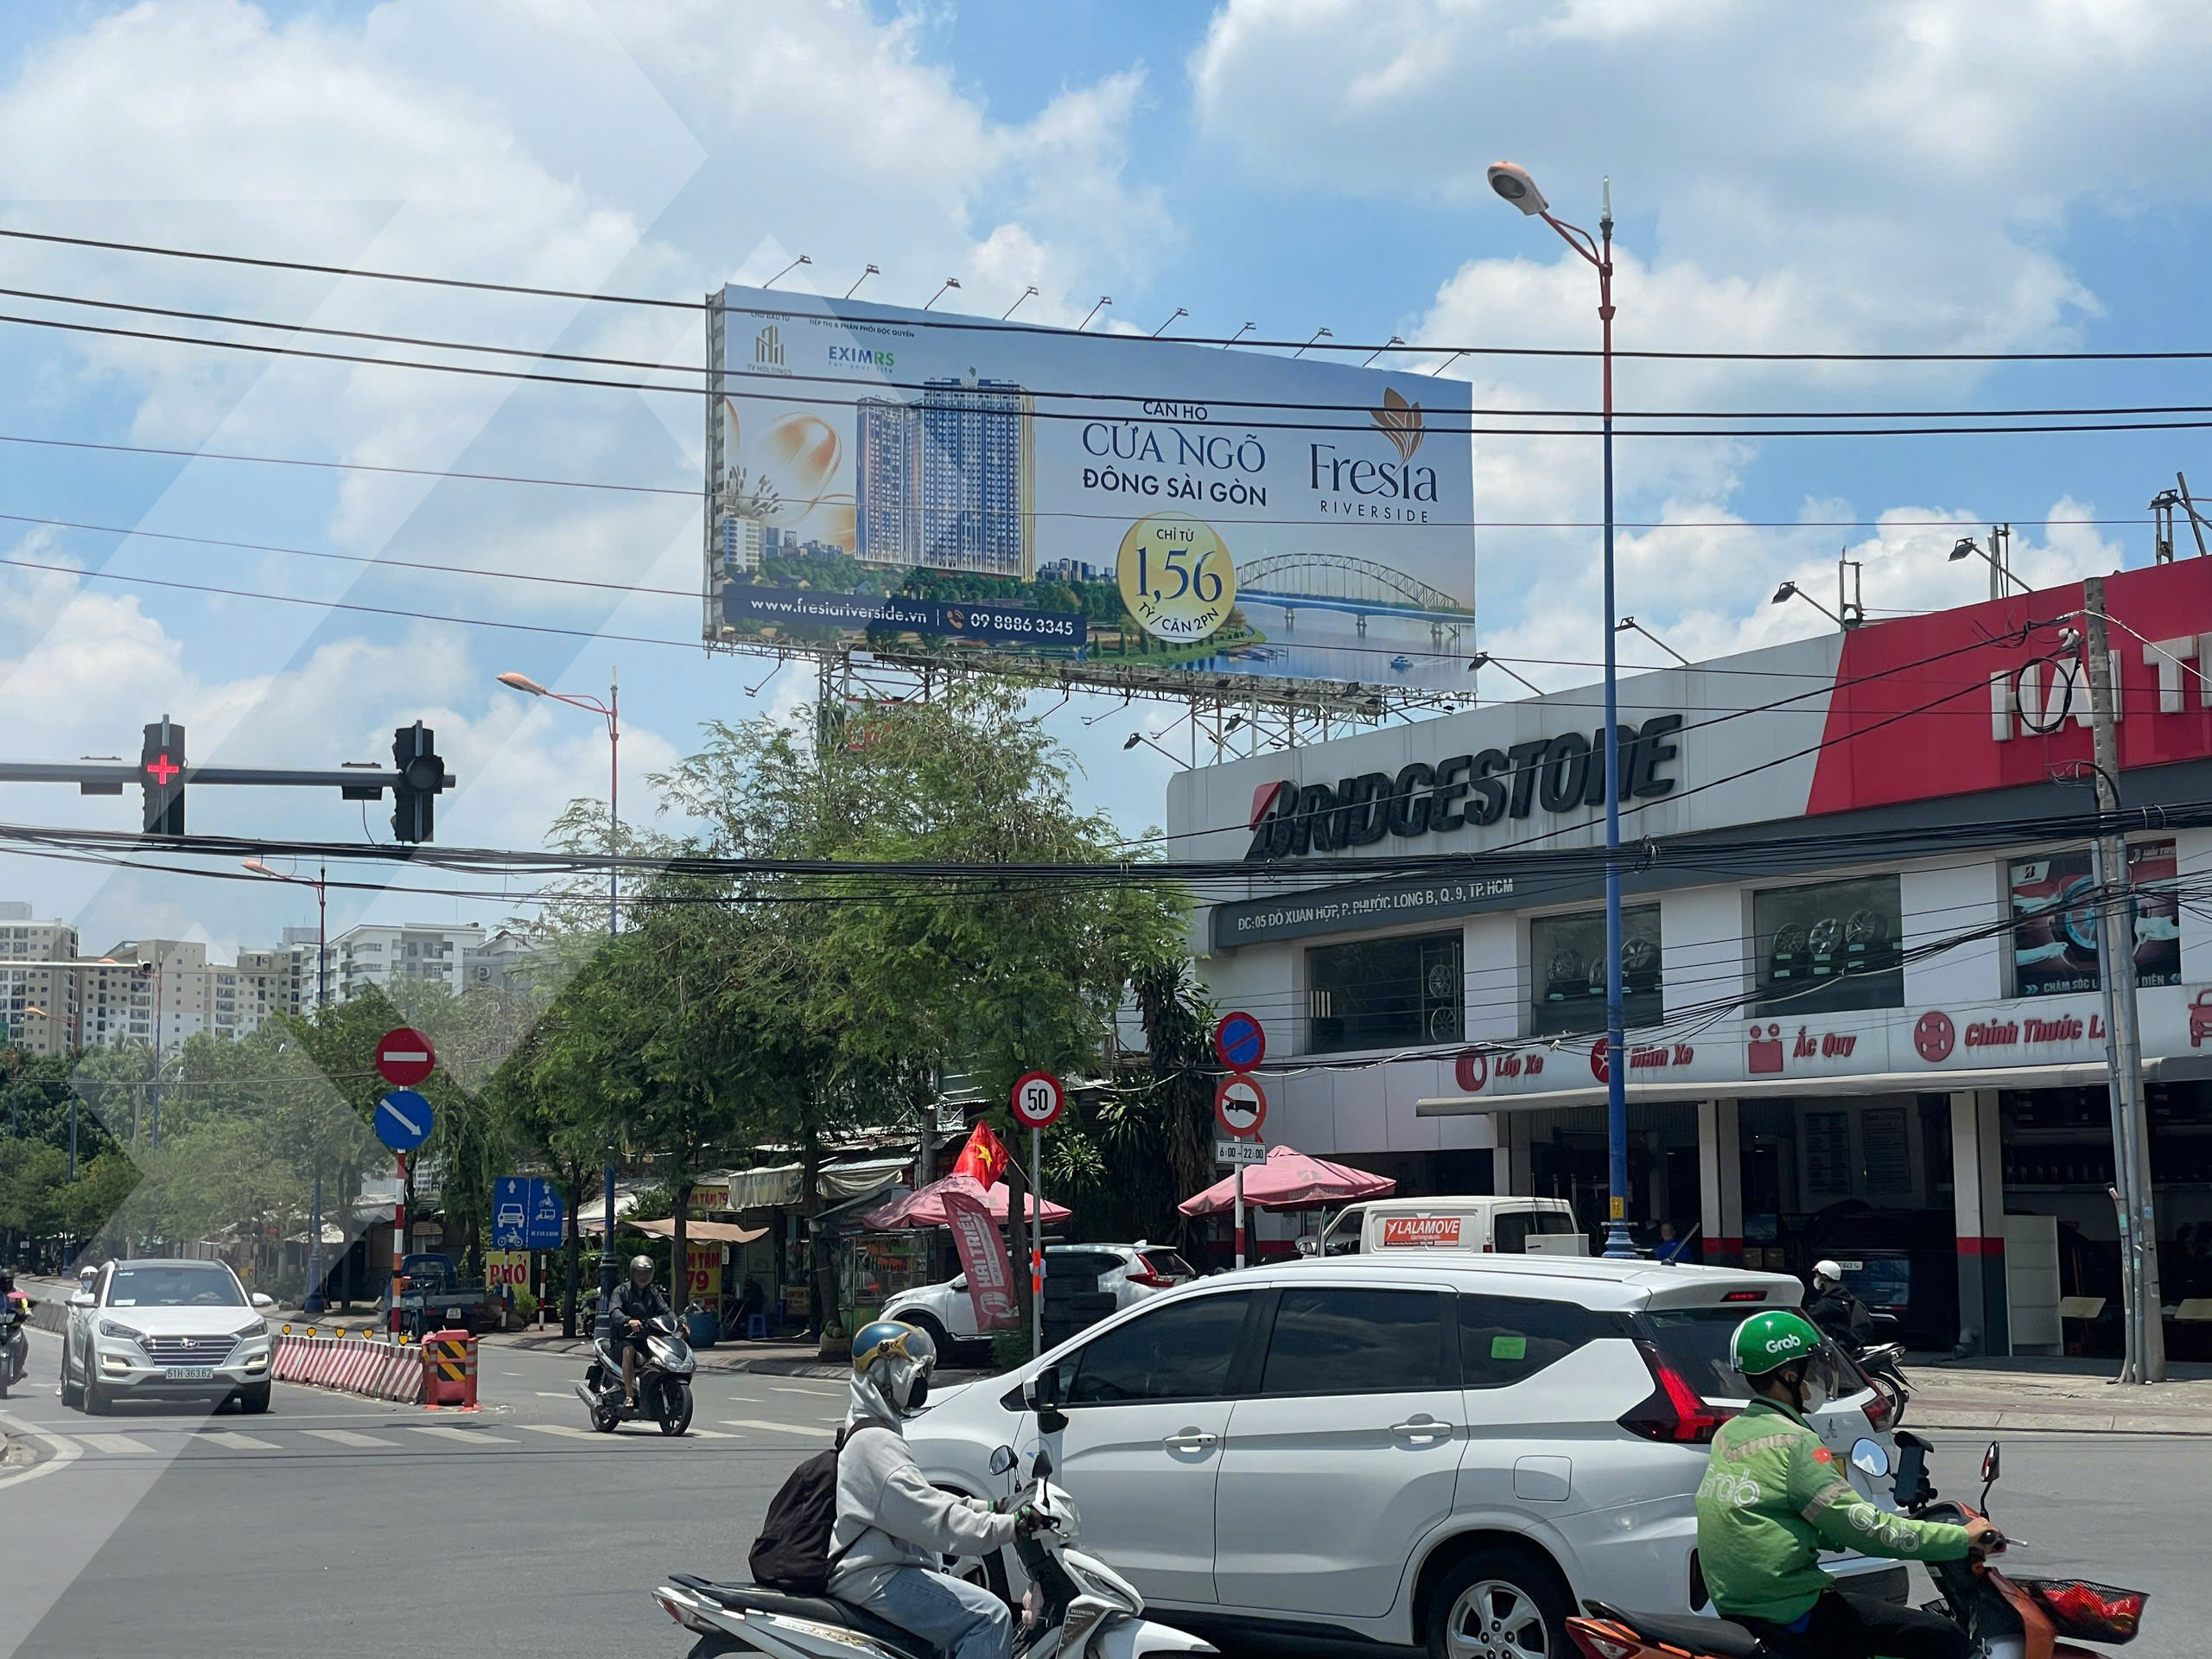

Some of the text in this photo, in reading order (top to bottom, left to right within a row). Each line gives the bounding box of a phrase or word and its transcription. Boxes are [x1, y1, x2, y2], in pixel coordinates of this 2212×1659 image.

[829, 346, 895, 366] EXIMRS
[757, 365, 792, 376] HOLDINGS
[1167, 427, 1266, 474] NGÕ
[1311, 443, 1438, 502] Fresia
[1083, 465, 1266, 507] ĐÔNG SÀI GÒN
[1320, 500, 1428, 523] RIVERSIDE
[1156, 526, 1195, 542] CHỈ TỪ
[1135, 546, 1223, 604] 1,56
[751, 597, 1074, 636] www.fresiariverside.vn 09 8886 3345
[1161, 618, 1192, 633] CĂN
[1194, 607, 1219, 630] 2PN
[1245, 714, 1683, 861] BRIDGESTONE
[1394, 892, 1423, 908] LONG
[1486, 877, 1514, 895] HCM
[2044, 980, 2070, 993] CHĂM
[2072, 977, 2090, 990] SÓC
[1964, 1018, 2018, 1046] Chỉnh
[2024, 1014, 2083, 1043] Thước
[1672, 1044, 1694, 1065] Xe
[1821, 1032, 1857, 1058] Quy
[1495, 1052, 1544, 1078] Lốp Xe
[1027, 1088, 1048, 1112] 50
[1397, 1220, 1460, 1235] LALAMOVE
[1765, 1333, 1802, 1354] Grab
[1071, 1608, 1096, 1617] HONDA
